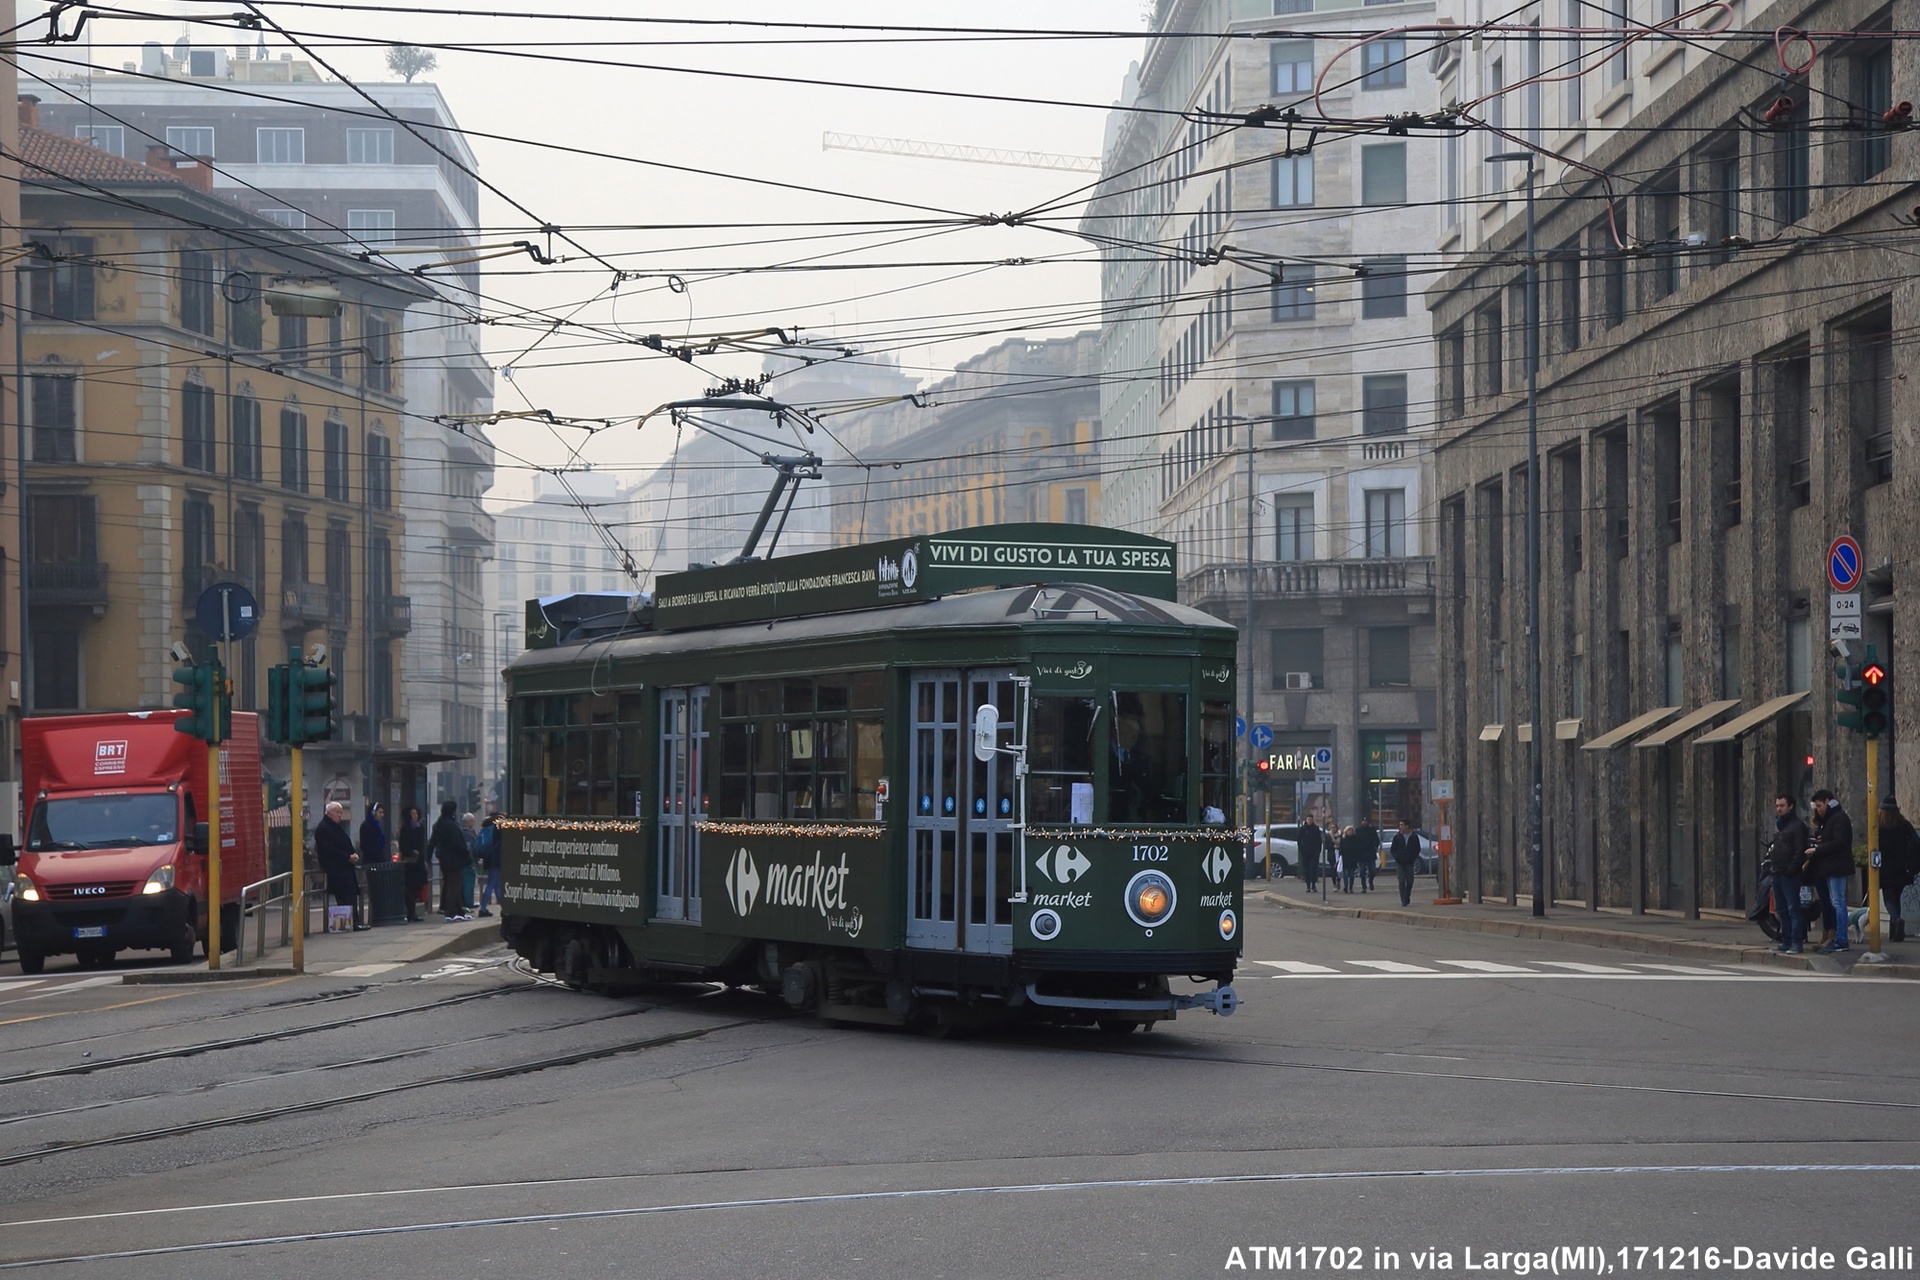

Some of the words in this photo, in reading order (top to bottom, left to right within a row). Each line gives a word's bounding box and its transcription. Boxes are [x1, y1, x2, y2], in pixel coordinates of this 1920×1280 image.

[929, 545, 964, 562] VIVI
[970, 546, 988, 563] DI
[994, 547, 1052, 564] GUSTO
[1058, 549, 1078, 565] LA
[1083, 550, 1117, 566] TUA
[1122, 551, 1172, 568] SPESA
[658, 597, 668, 609] SALI
[672, 594, 688, 607] BORDO
[698, 592, 704, 603] LA
[724, 587, 745, 600] RICAVATO
[761, 581, 786, 595] DEVOLUTO
[787, 580, 799, 592] ALLA
[799, 575, 831, 590] FONDAZIONE
[832, 571, 861, 586] FRANCESCA
[862, 569, 876, 582] RAVA
[1836, 600, 1854, 609] 0-24
[98, 744, 125, 756] BRT
[522, 836, 530, 852] La
[530, 839, 556, 857] gourmet
[556, 838, 589, 859] experience
[590, 839, 619, 856] continua
[1132, 845, 1169, 862] 1702
[520, 860, 530, 876] nei
[530, 861, 548, 877] nostri
[548, 863, 589, 882] supermercati
[589, 863, 597, 880] di
[597, 864, 621, 882] Milano.
[73, 887, 106, 895] IVECO
[504, 881, 523, 904] Scopri
[523, 883, 537, 900] dove
[537, 888, 545, 901] su
[766, 849, 850, 918] market
[1033, 891, 1092, 909] market
[1200, 891, 1233, 908] market
